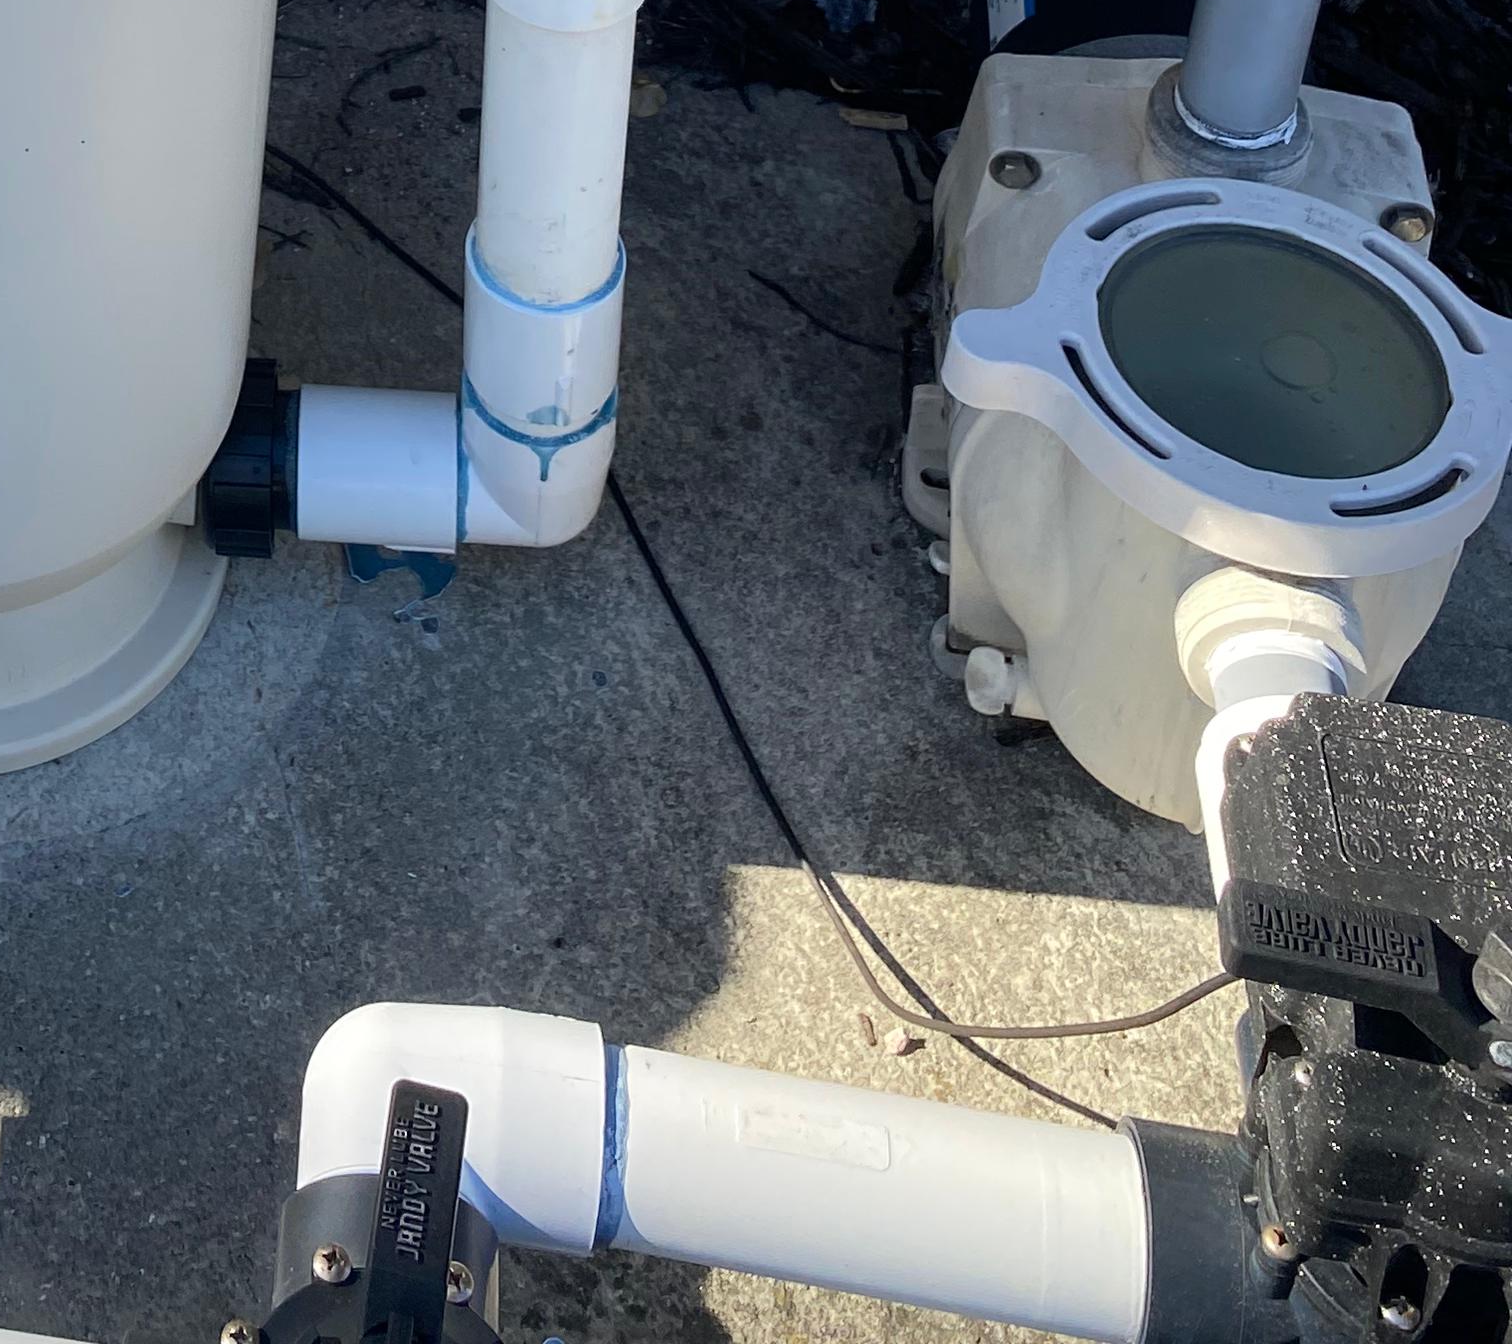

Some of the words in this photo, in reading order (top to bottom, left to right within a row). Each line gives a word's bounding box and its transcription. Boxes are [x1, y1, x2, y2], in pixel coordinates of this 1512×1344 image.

[1245, 902, 1334, 944] VALVE
[1332, 922, 1428, 960] JANDY
[1334, 946, 1428, 978] NEVER
[390, 1116, 410, 1163] LUBE
[405, 1099, 441, 1173] VALVE
[380, 1168, 402, 1230] NEVER
[394, 1178, 430, 1265] JANDY
